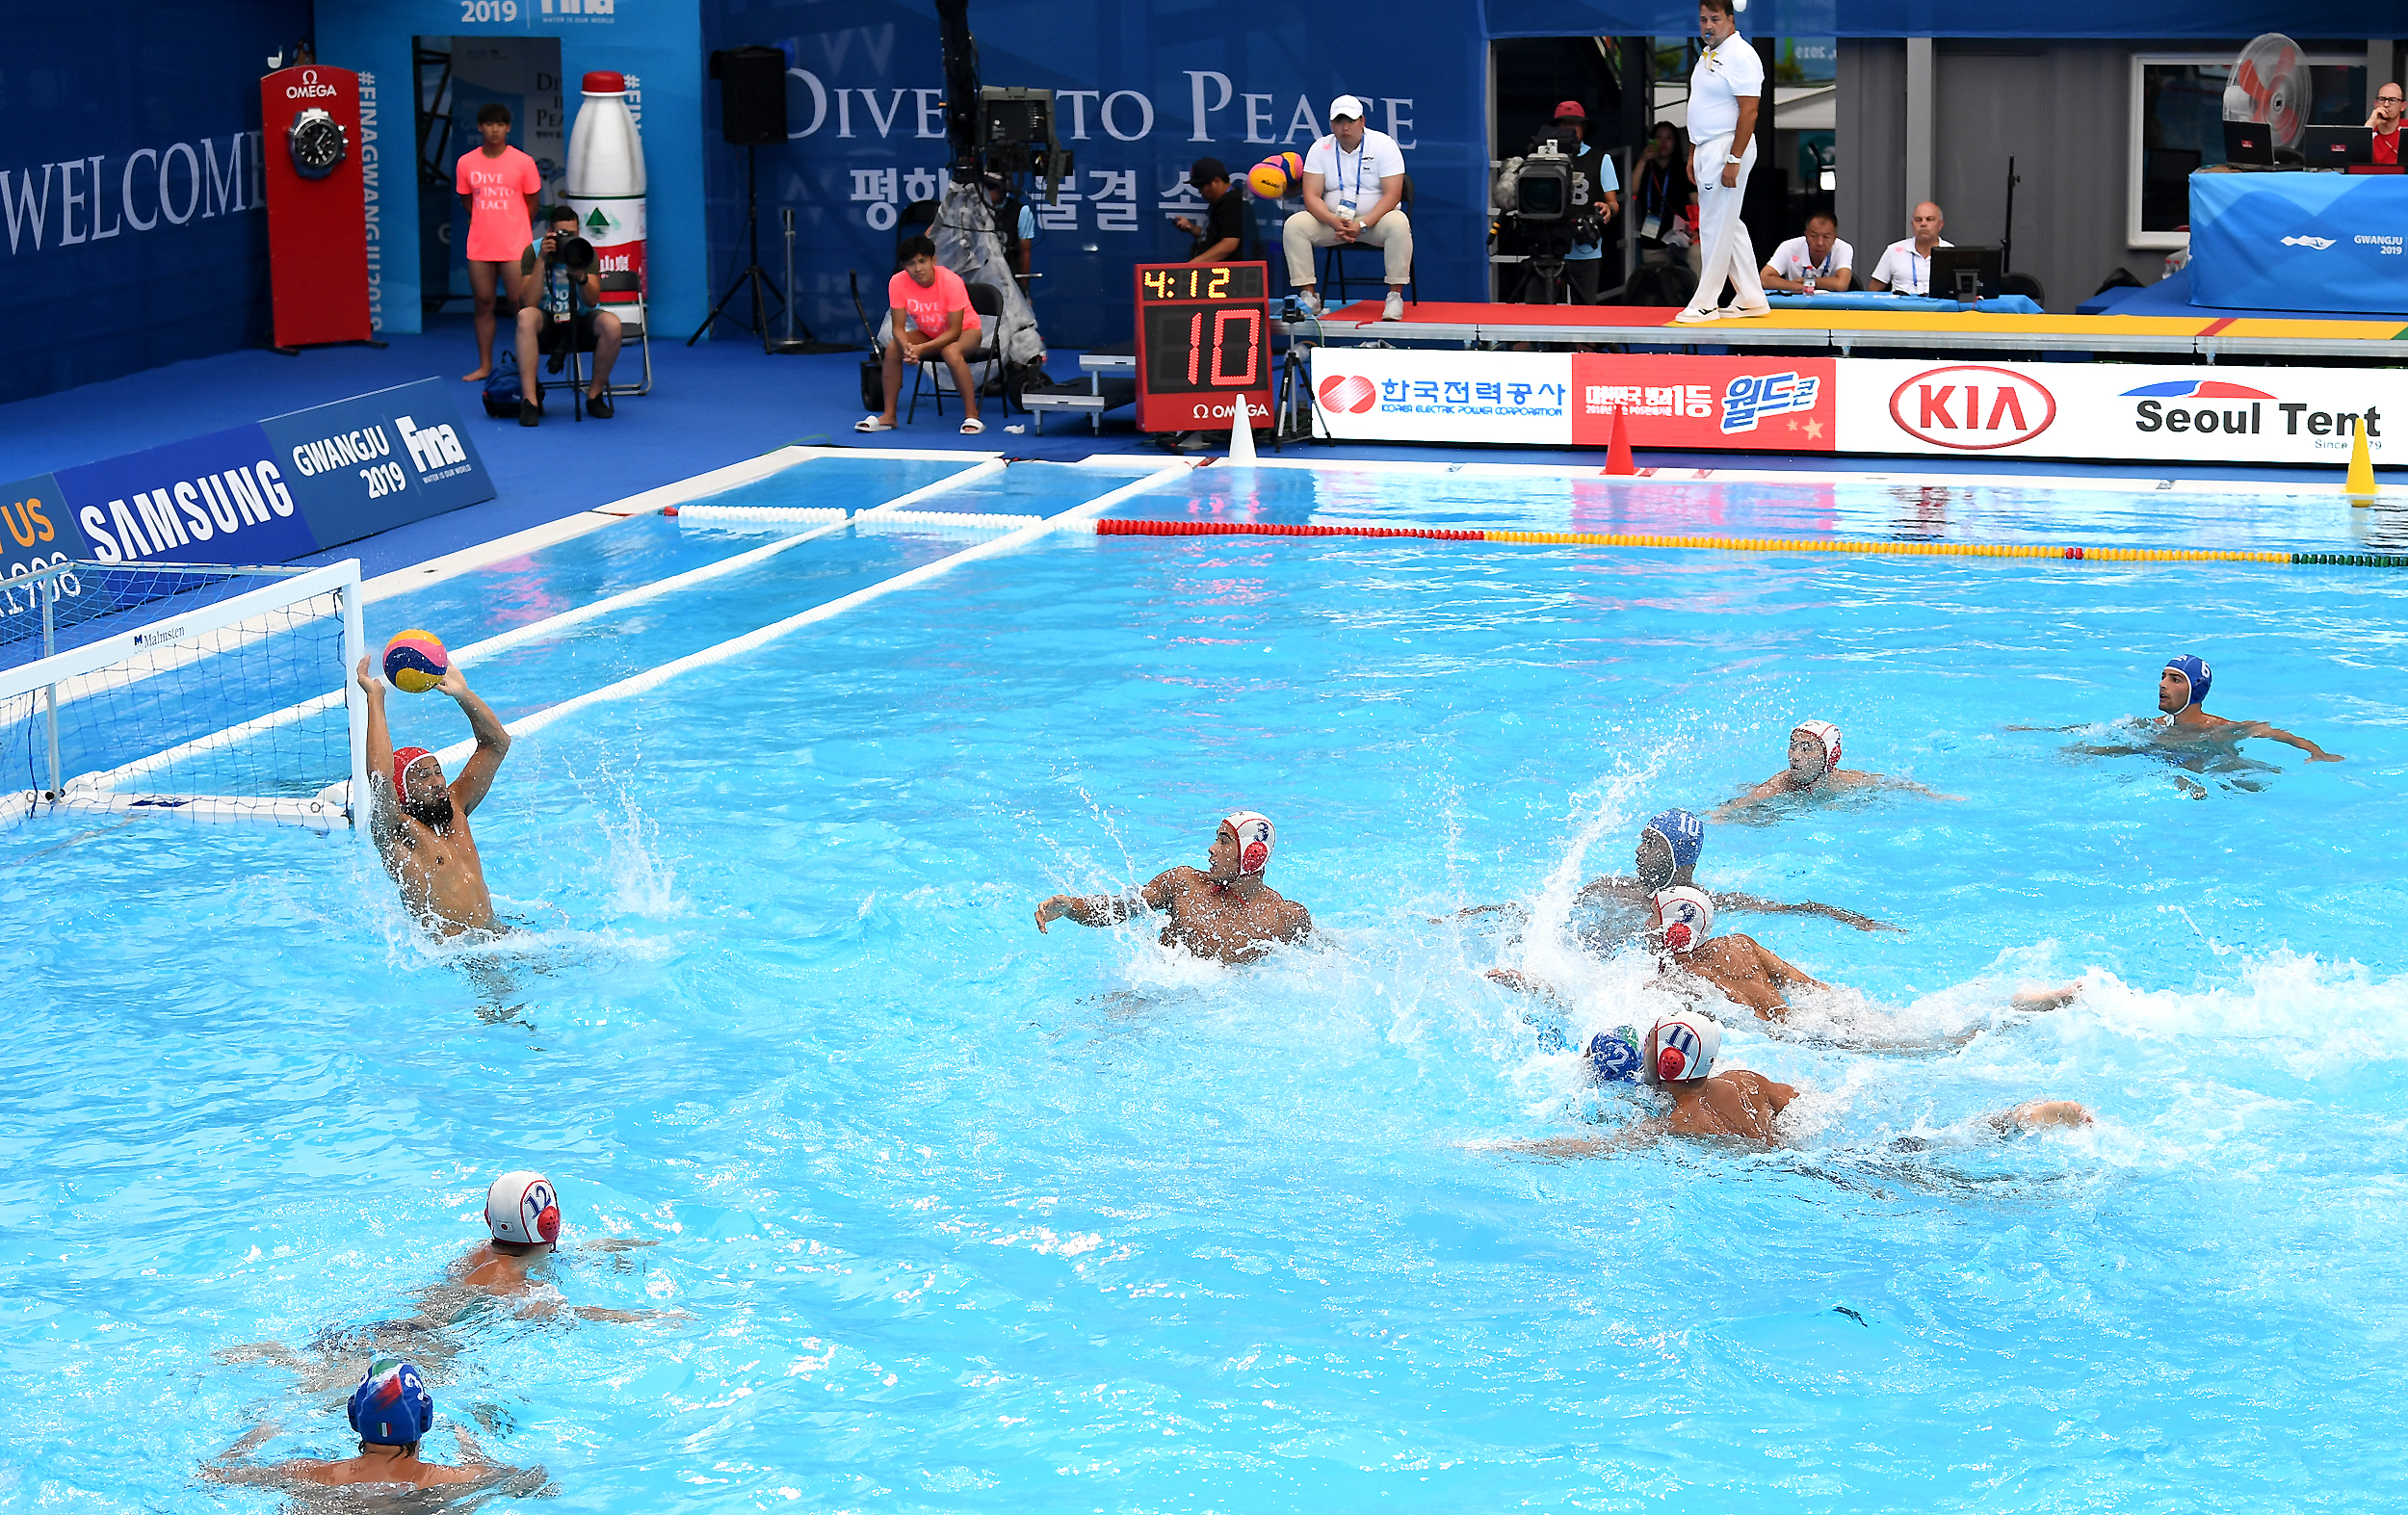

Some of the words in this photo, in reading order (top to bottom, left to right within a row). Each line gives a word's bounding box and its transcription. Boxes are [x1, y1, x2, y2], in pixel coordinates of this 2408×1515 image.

[461, 1, 518, 23] 2019
[286, 84, 337, 99] OMEGA
[1056, 90, 1154, 142] TO
[1183, 70, 1417, 149] PEAE
[470, 171, 504, 185] DIVE
[484, 187, 514, 197] INTO
[2353, 234, 2403, 246] GWANGJU
[2380, 246, 2403, 255] 2019
[1144, 268, 1230, 299] 4:12
[1188, 308, 1261, 386] 10
[1381, 379, 1566, 405] 한국전력공사
[1212, 404, 1269, 418] OMGA
[1381, 405, 1413, 413] KOREA
[1415, 405, 1455, 414] ELECTRIC
[1458, 405, 1493, 415] POWER
[1495, 406, 1562, 417] CORPORATION
[1918, 384, 2028, 431] KIA
[2135, 400, 2261, 433] Seoul
[2278, 403, 2381, 437] Tent
[293, 425, 390, 477] GWANGJU
[394, 416, 467, 474] Fina
[2315, 439, 2348, 450] Since
[360, 461, 406, 499] 2019
[1, 498, 55, 548] US
[80, 460, 295, 562] SAMSUNG
[144, 626, 185, 649] Malmsten
[1253, 822, 1269, 843] 3
[1678, 812, 1701, 837] 10
[1665, 1024, 1696, 1058] 11
[523, 1184, 553, 1220] 12
